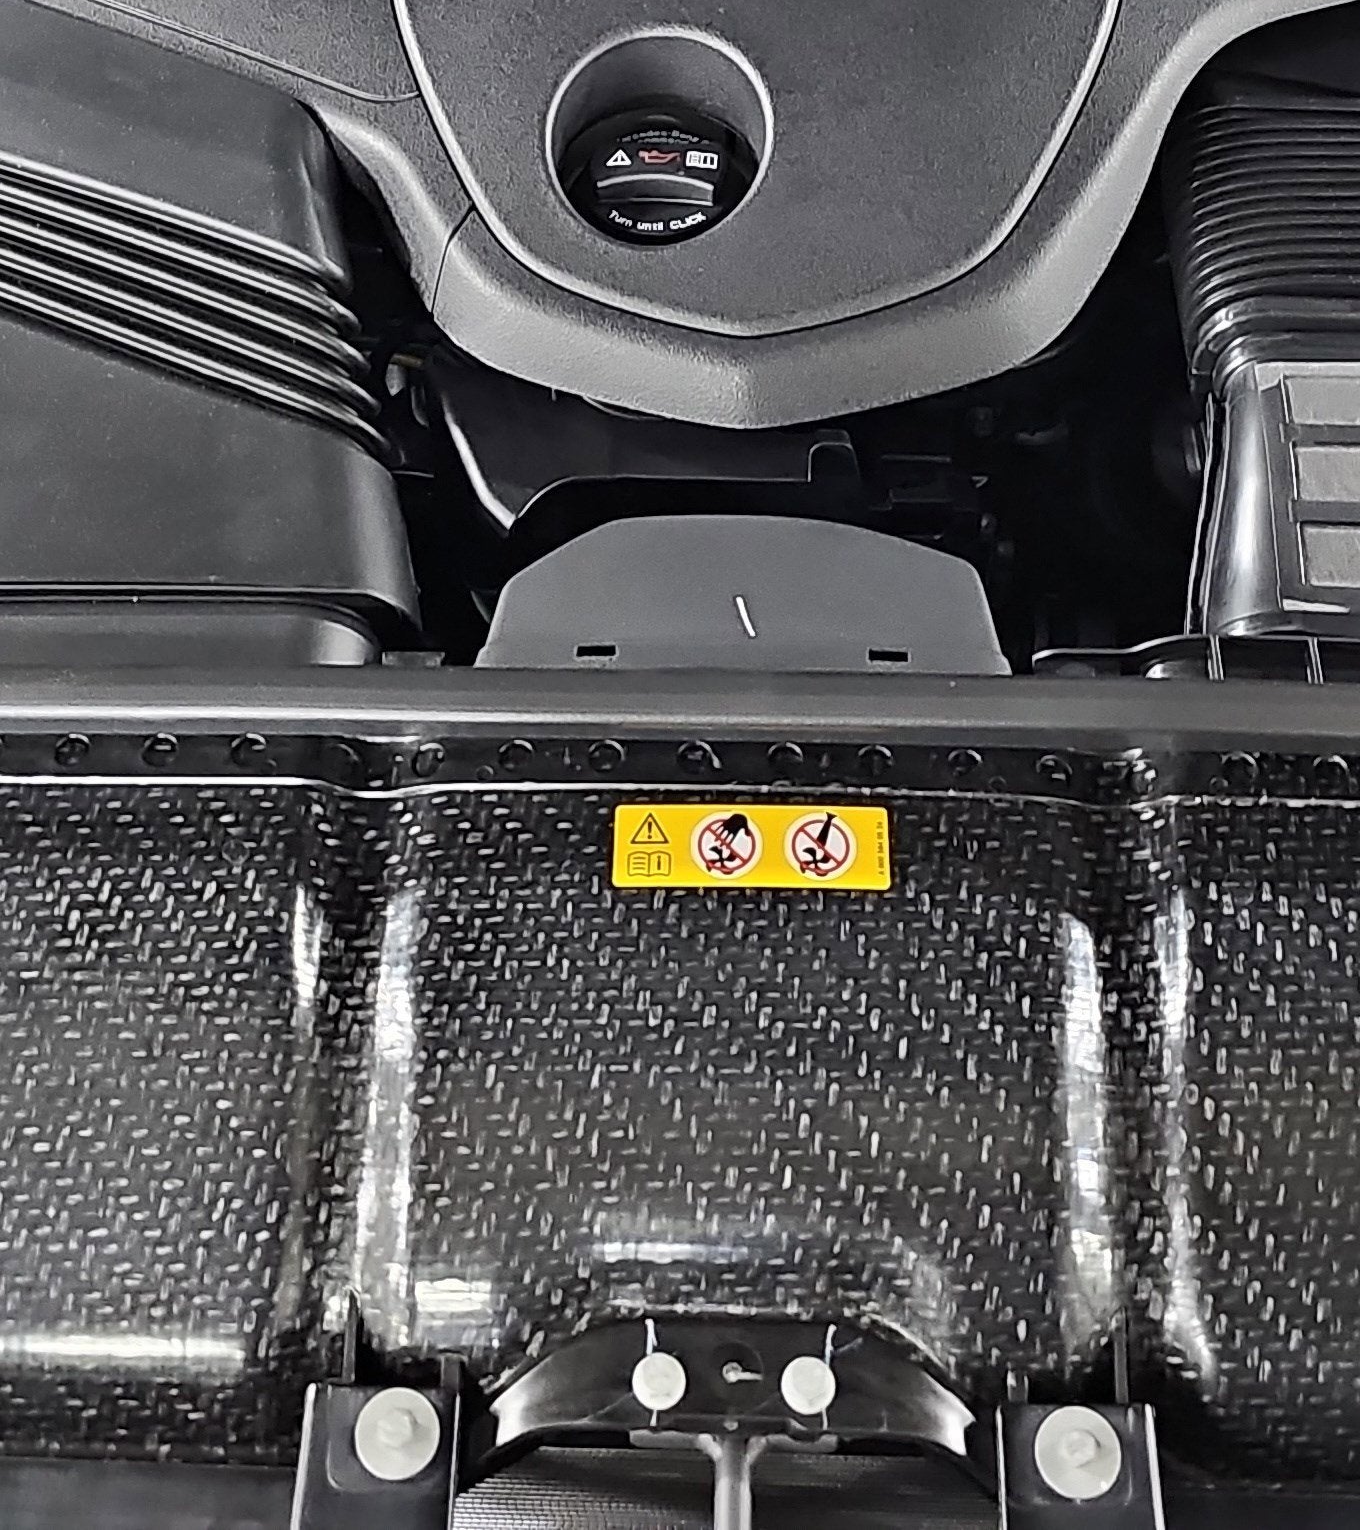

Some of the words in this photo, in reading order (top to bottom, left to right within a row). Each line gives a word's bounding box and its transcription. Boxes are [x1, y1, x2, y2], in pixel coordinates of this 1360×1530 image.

[608, 209, 633, 227] Turn
[636, 221, 664, 231] until
[669, 211, 707, 230] CLICK
